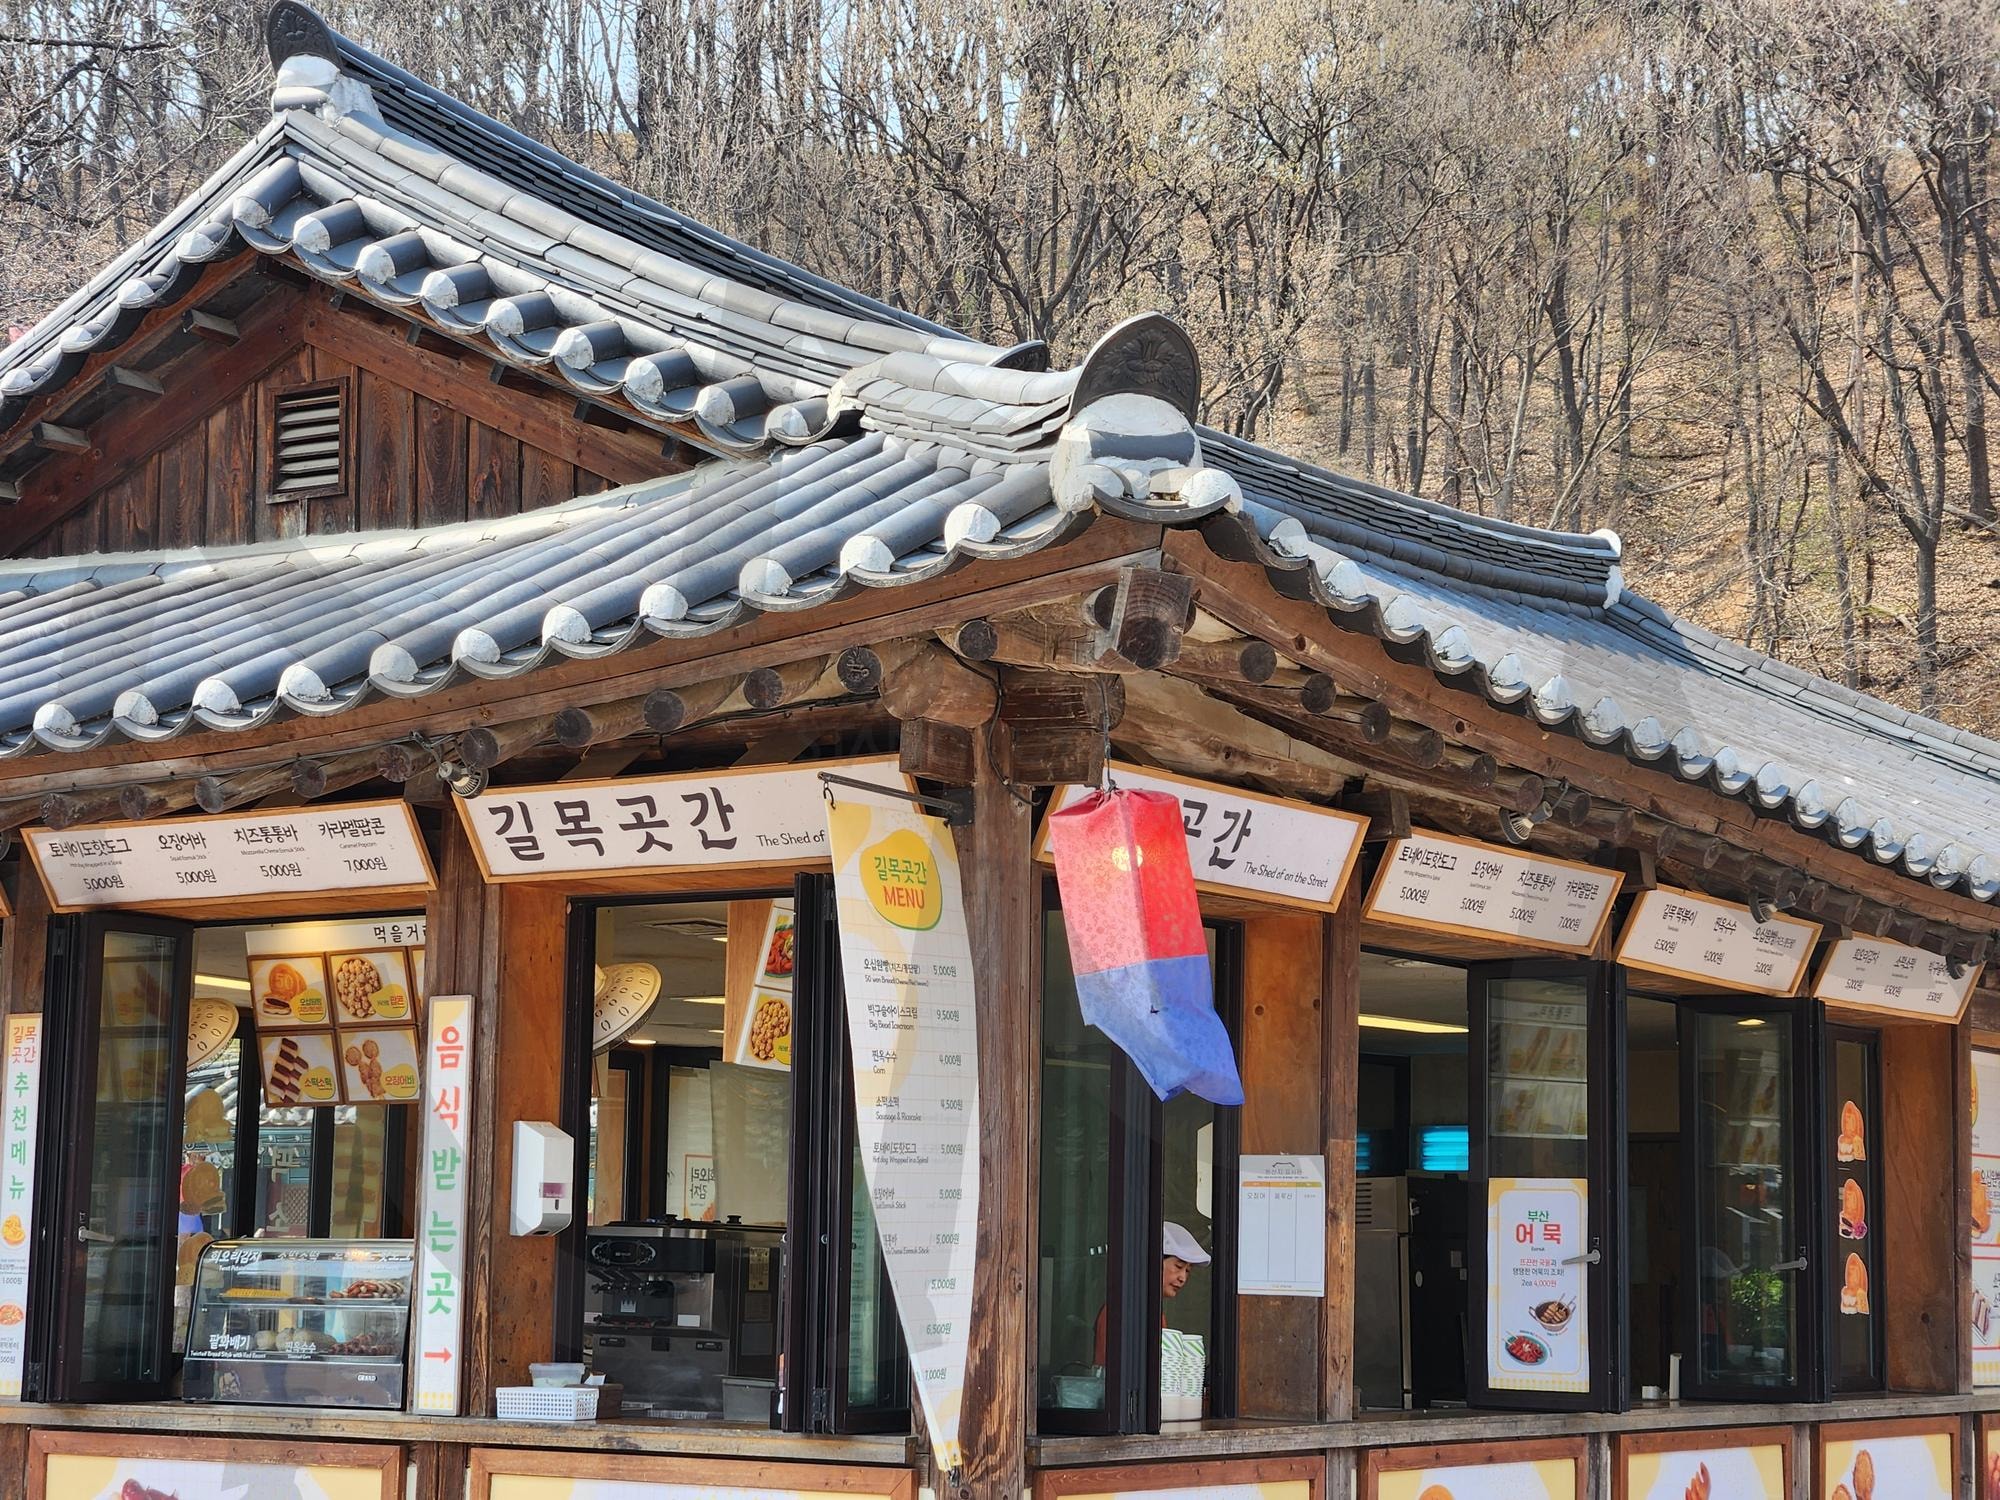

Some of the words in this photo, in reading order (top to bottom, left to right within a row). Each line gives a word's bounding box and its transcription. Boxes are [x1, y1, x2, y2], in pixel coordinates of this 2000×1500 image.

[488, 786, 738, 862] 길목곳간
[48, 838, 132, 859] 토네이도핫도그
[158, 831, 207, 852] 오징어바
[233, 823, 298, 846] 치즈통통바
[317, 817, 386, 840] 카라멜팝콘
[756, 834, 779, 849] The
[780, 831, 810, 847] Shed
[813, 829, 826, 845] of
[1183, 799, 1252, 870] 간
[259, 861, 302, 880] 5,000원
[343, 855, 388, 874] 7,000원
[873, 855, 928, 886] 길목곳간
[1398, 845, 1458, 871] 토네이도핫도그
[1471, 860, 1504, 881] 오징어바
[1516, 868, 1557, 893] 치즈통통바
[83, 873, 125, 891] 5,000원
[175, 868, 217, 886] 5,000원
[1244, 861, 1257, 876] The
[1257, 864, 1276, 879] Shed
[1276, 867, 1285, 880] of
[1285, 872, 1294, 881] on
[1294, 871, 1307, 885] the
[1307, 873, 1329, 889] Street
[883, 885, 926, 910] MENU
[1399, 886, 1430, 904] 5,000원
[1459, 896, 1487, 914] 5,000원
[1509, 906, 1537, 924] 5,000원
[1712, 915, 1738, 936] 찐옥수수
[932, 964, 958, 978] 5,000원
[936, 1008, 960, 1022] 9,500원
[13, 1025, 37, 1044] 길목
[11, 1045, 37, 1064] 곳간
[871, 1049, 898, 1063] 찐옥수수
[938, 1054, 962, 1067] 4,000원
[872, 1065, 886, 1075] Corn
[875, 1096, 900, 1108] 소떡소떡
[940, 1099, 963, 1111] 4,500원
[9, 1071, 30, 1200] 추천메뉴
[873, 1141, 918, 1156] 토네이도핫도그
[940, 1143, 964, 1156] 5,000원
[938, 1188, 962, 1201] 5,000원
[1527, 1210, 1549, 1223] 부산
[935, 1233, 960, 1246] 5,000원
[1515, 1222, 1562, 1245] 어묵
[210, 1248, 262, 1264] 회오리감자
[1531, 1268, 1550, 1277] 어묵의
[931, 1277, 956, 1290] 5,000원
[1533, 1279, 1557, 1288] 4,000원
[926, 1321, 952, 1335] 6,500원
